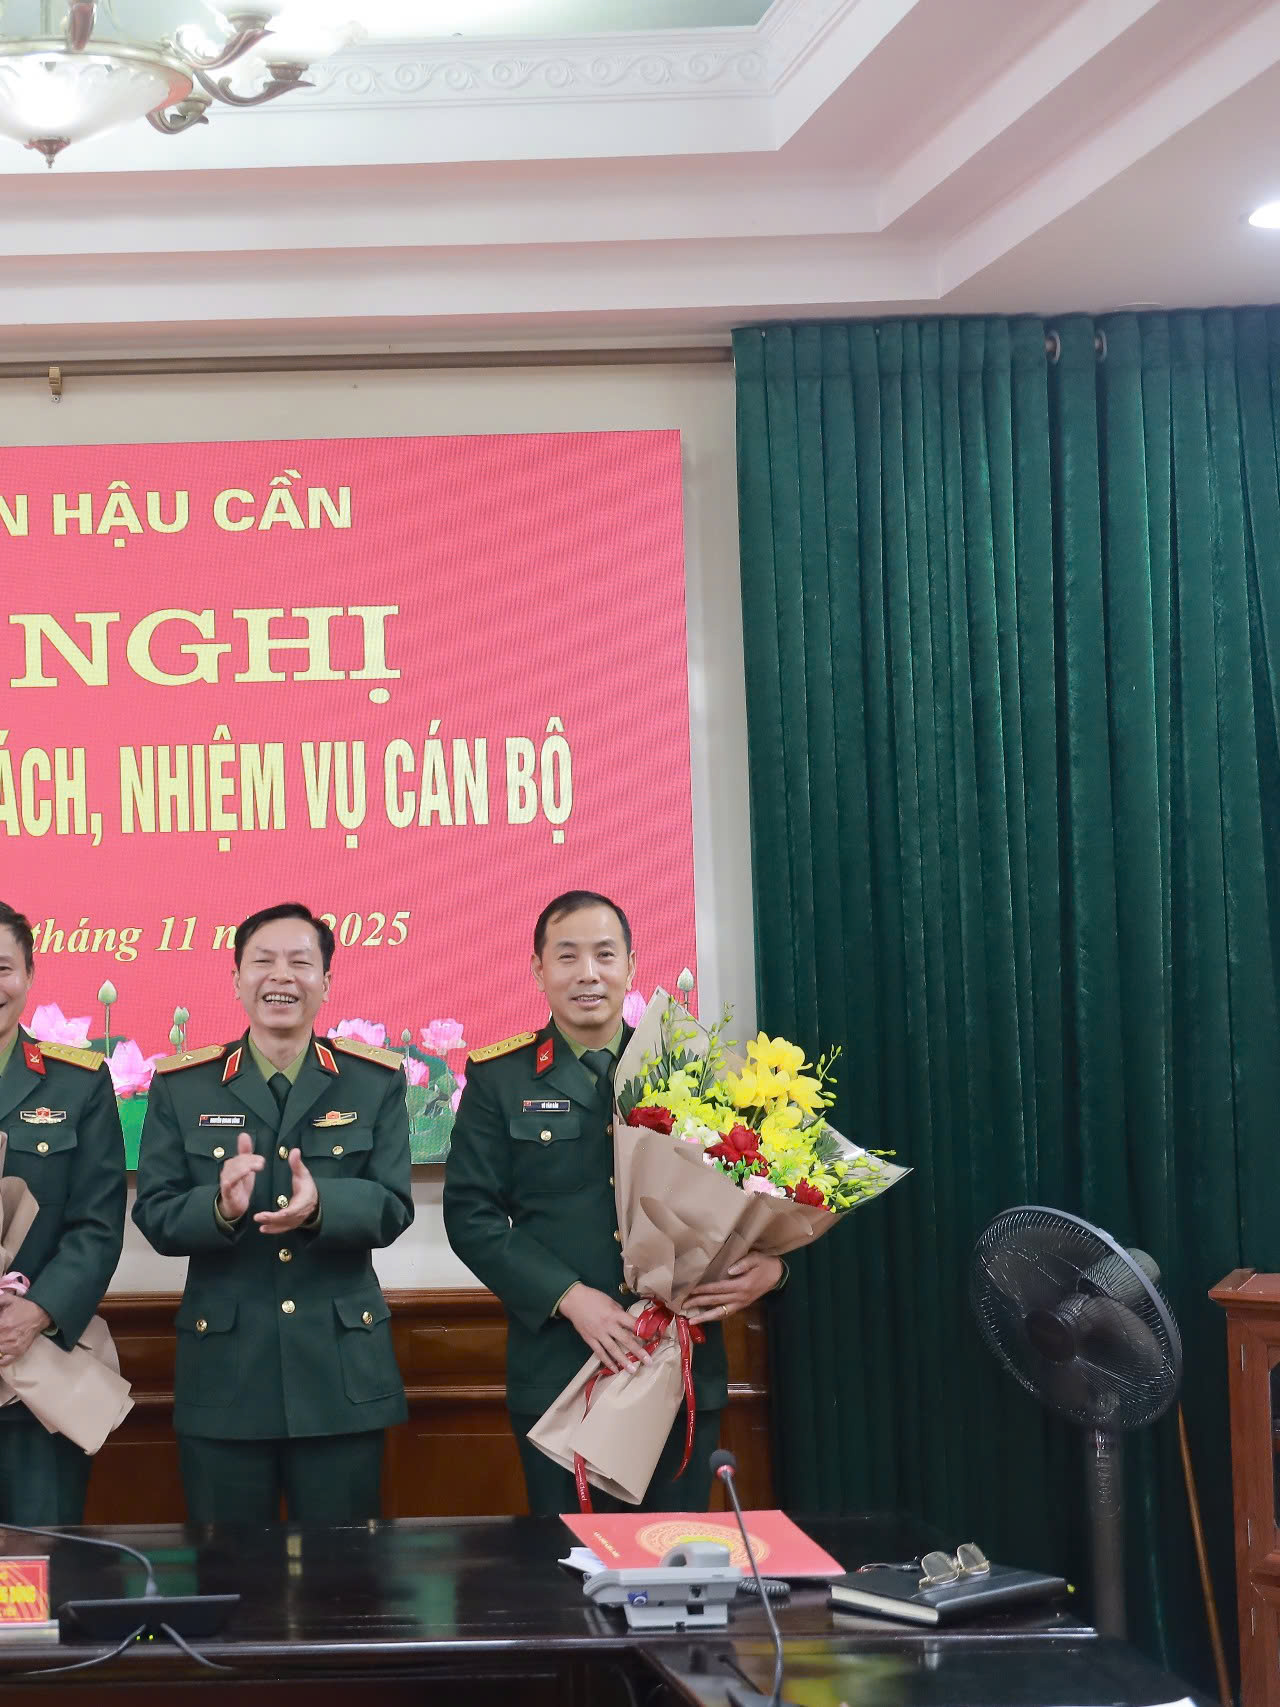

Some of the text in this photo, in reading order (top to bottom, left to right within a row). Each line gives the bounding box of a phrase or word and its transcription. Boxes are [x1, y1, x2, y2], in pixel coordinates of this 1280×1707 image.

[53, 480, 189, 548] HẬU
[213, 469, 352, 532] CẦN
[9, 605, 401, 704] NGHỊ
[119, 724, 286, 852] NHIỆM
[301, 738, 367, 849] VỤ
[384, 719, 489, 829] CÁN
[505, 716, 573, 844] BỘ
[30, 917, 143, 962] tháng
[154, 916, 198, 951] 11
